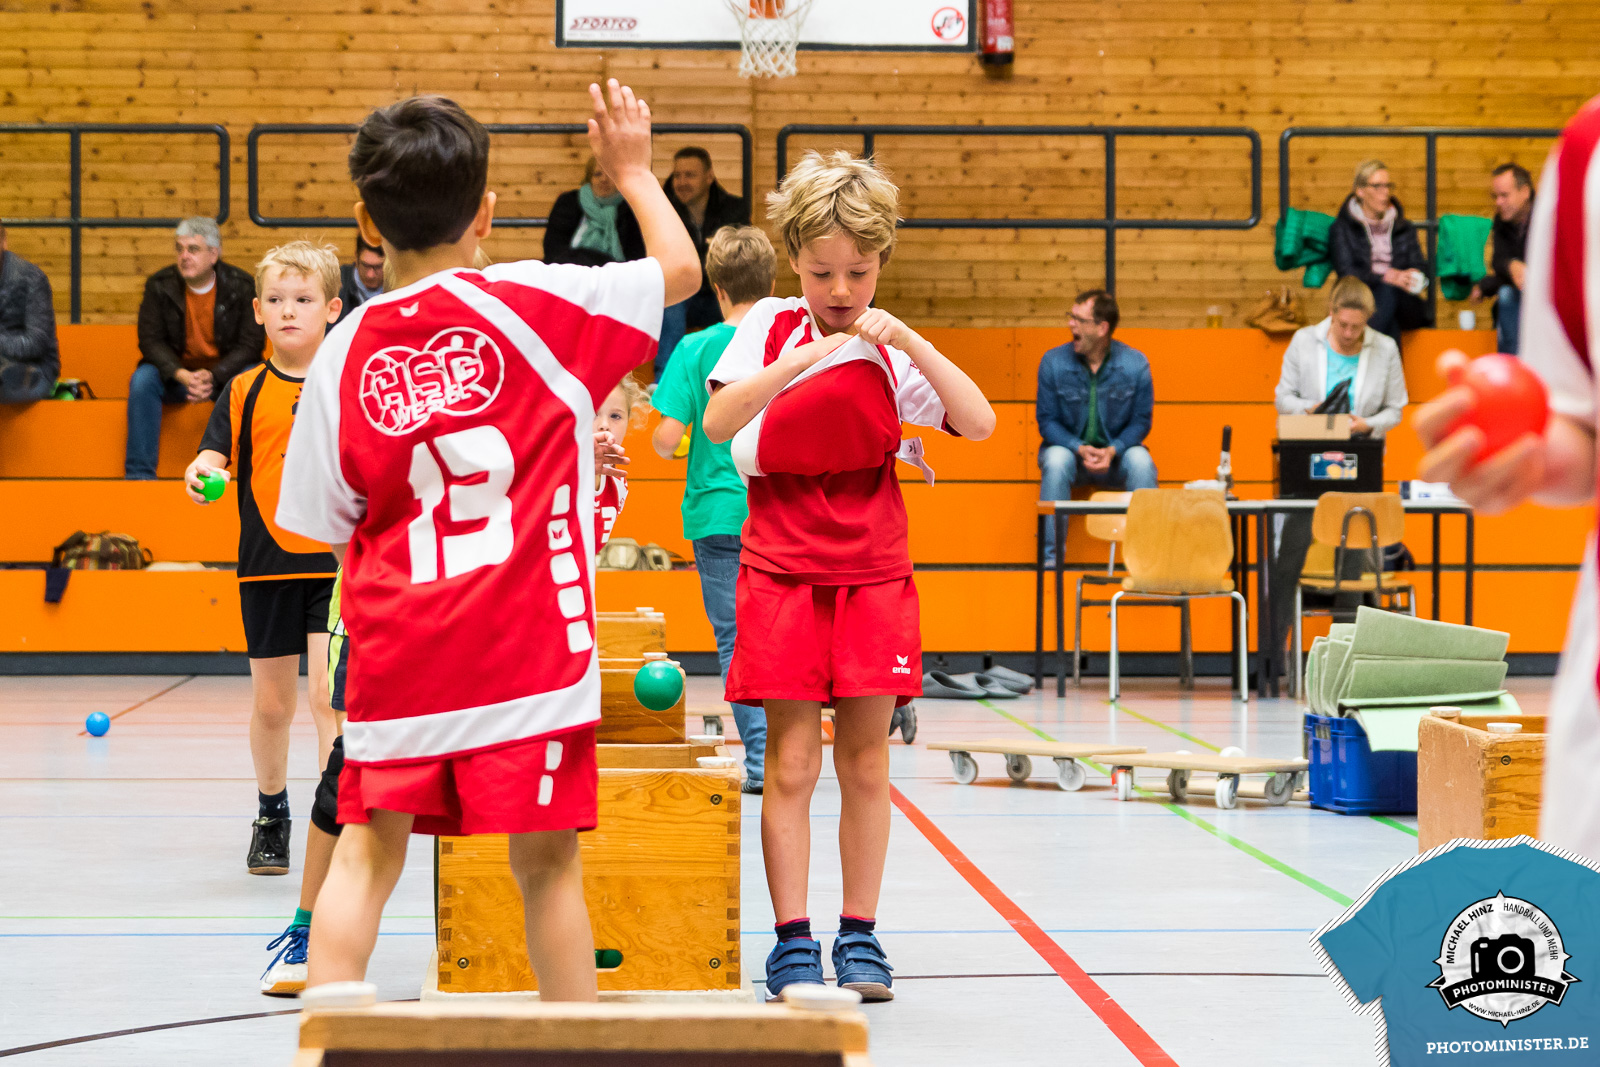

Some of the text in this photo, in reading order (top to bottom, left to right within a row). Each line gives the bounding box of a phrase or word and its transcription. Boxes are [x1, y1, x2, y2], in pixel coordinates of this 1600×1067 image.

[374, 349, 485, 410] HSG
[389, 382, 473, 426] WESEL
[407, 424, 516, 584] 13
